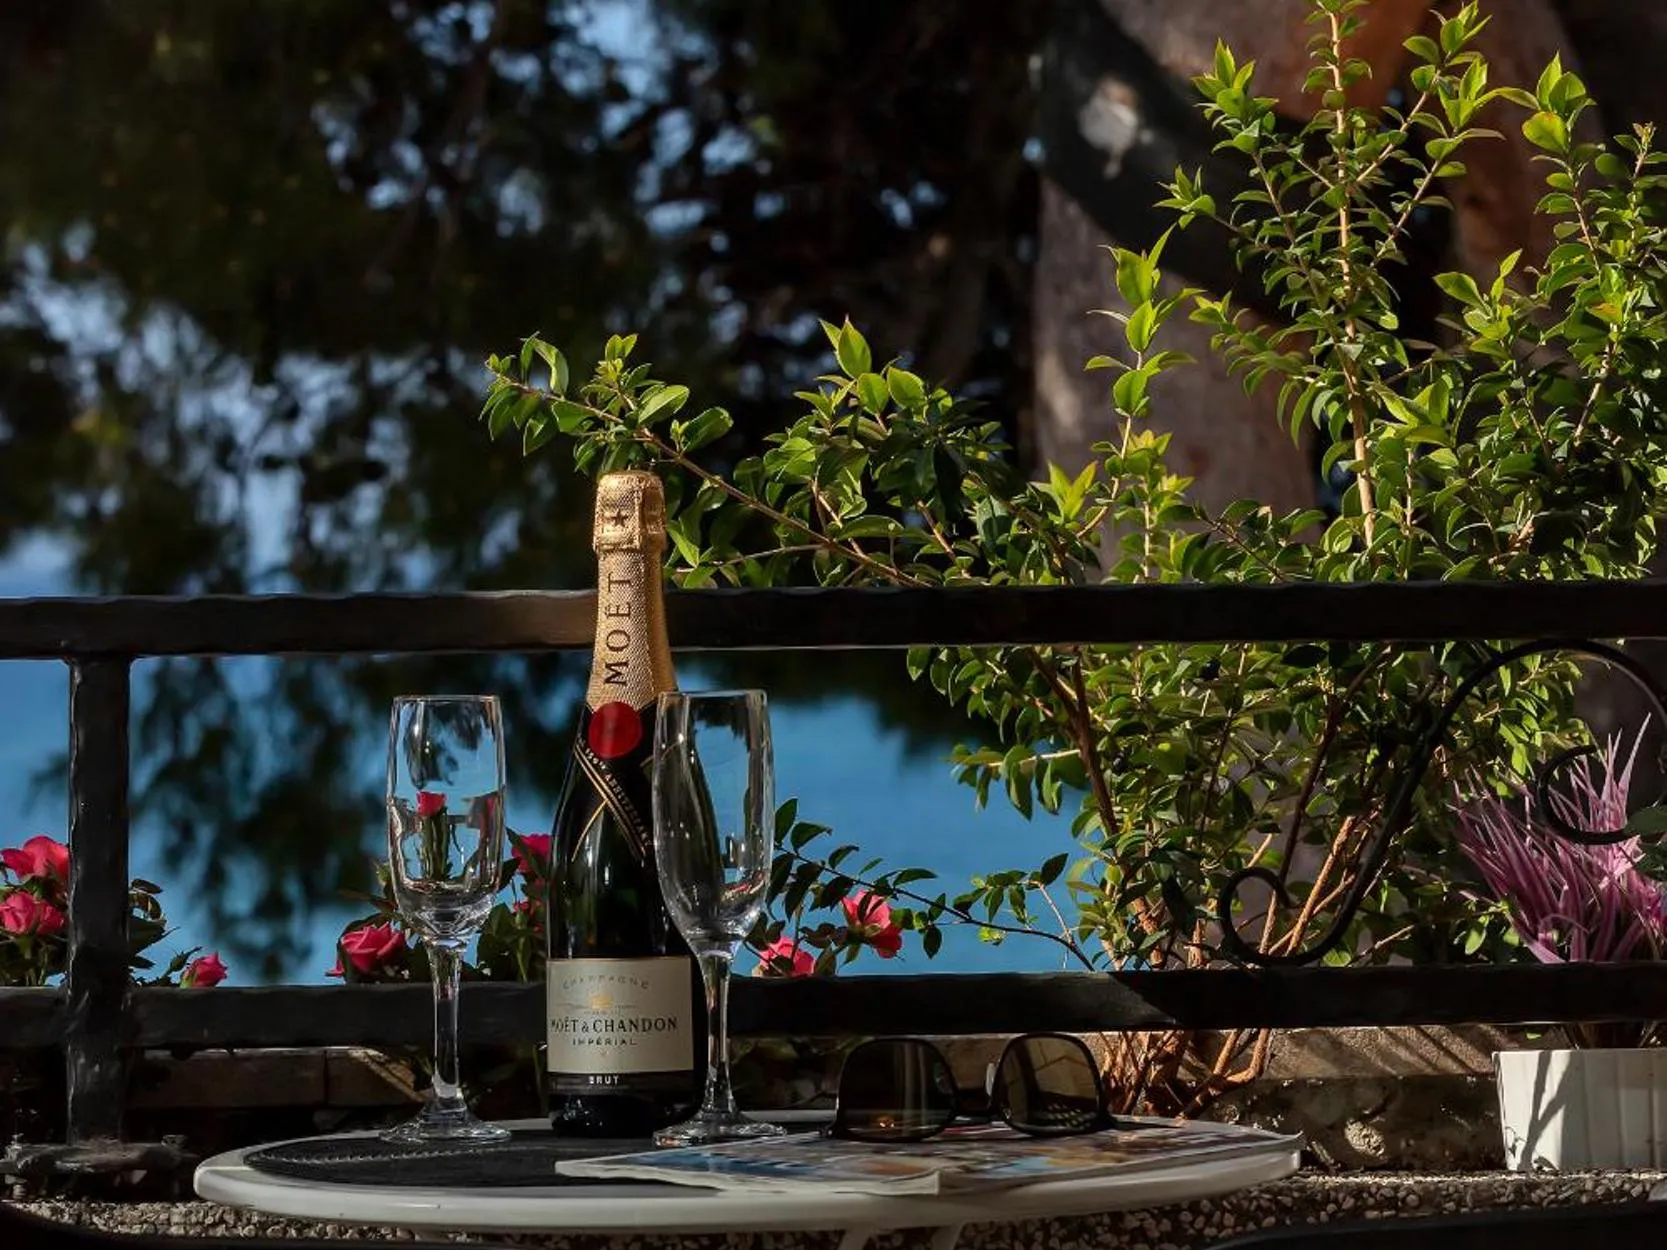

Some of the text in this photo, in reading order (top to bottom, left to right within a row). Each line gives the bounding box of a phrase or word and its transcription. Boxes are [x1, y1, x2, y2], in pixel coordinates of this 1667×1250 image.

[581, 1021, 589, 1032] &
[593, 1017, 678, 1033] CHANDON
[589, 1075, 619, 1085] BRUT
